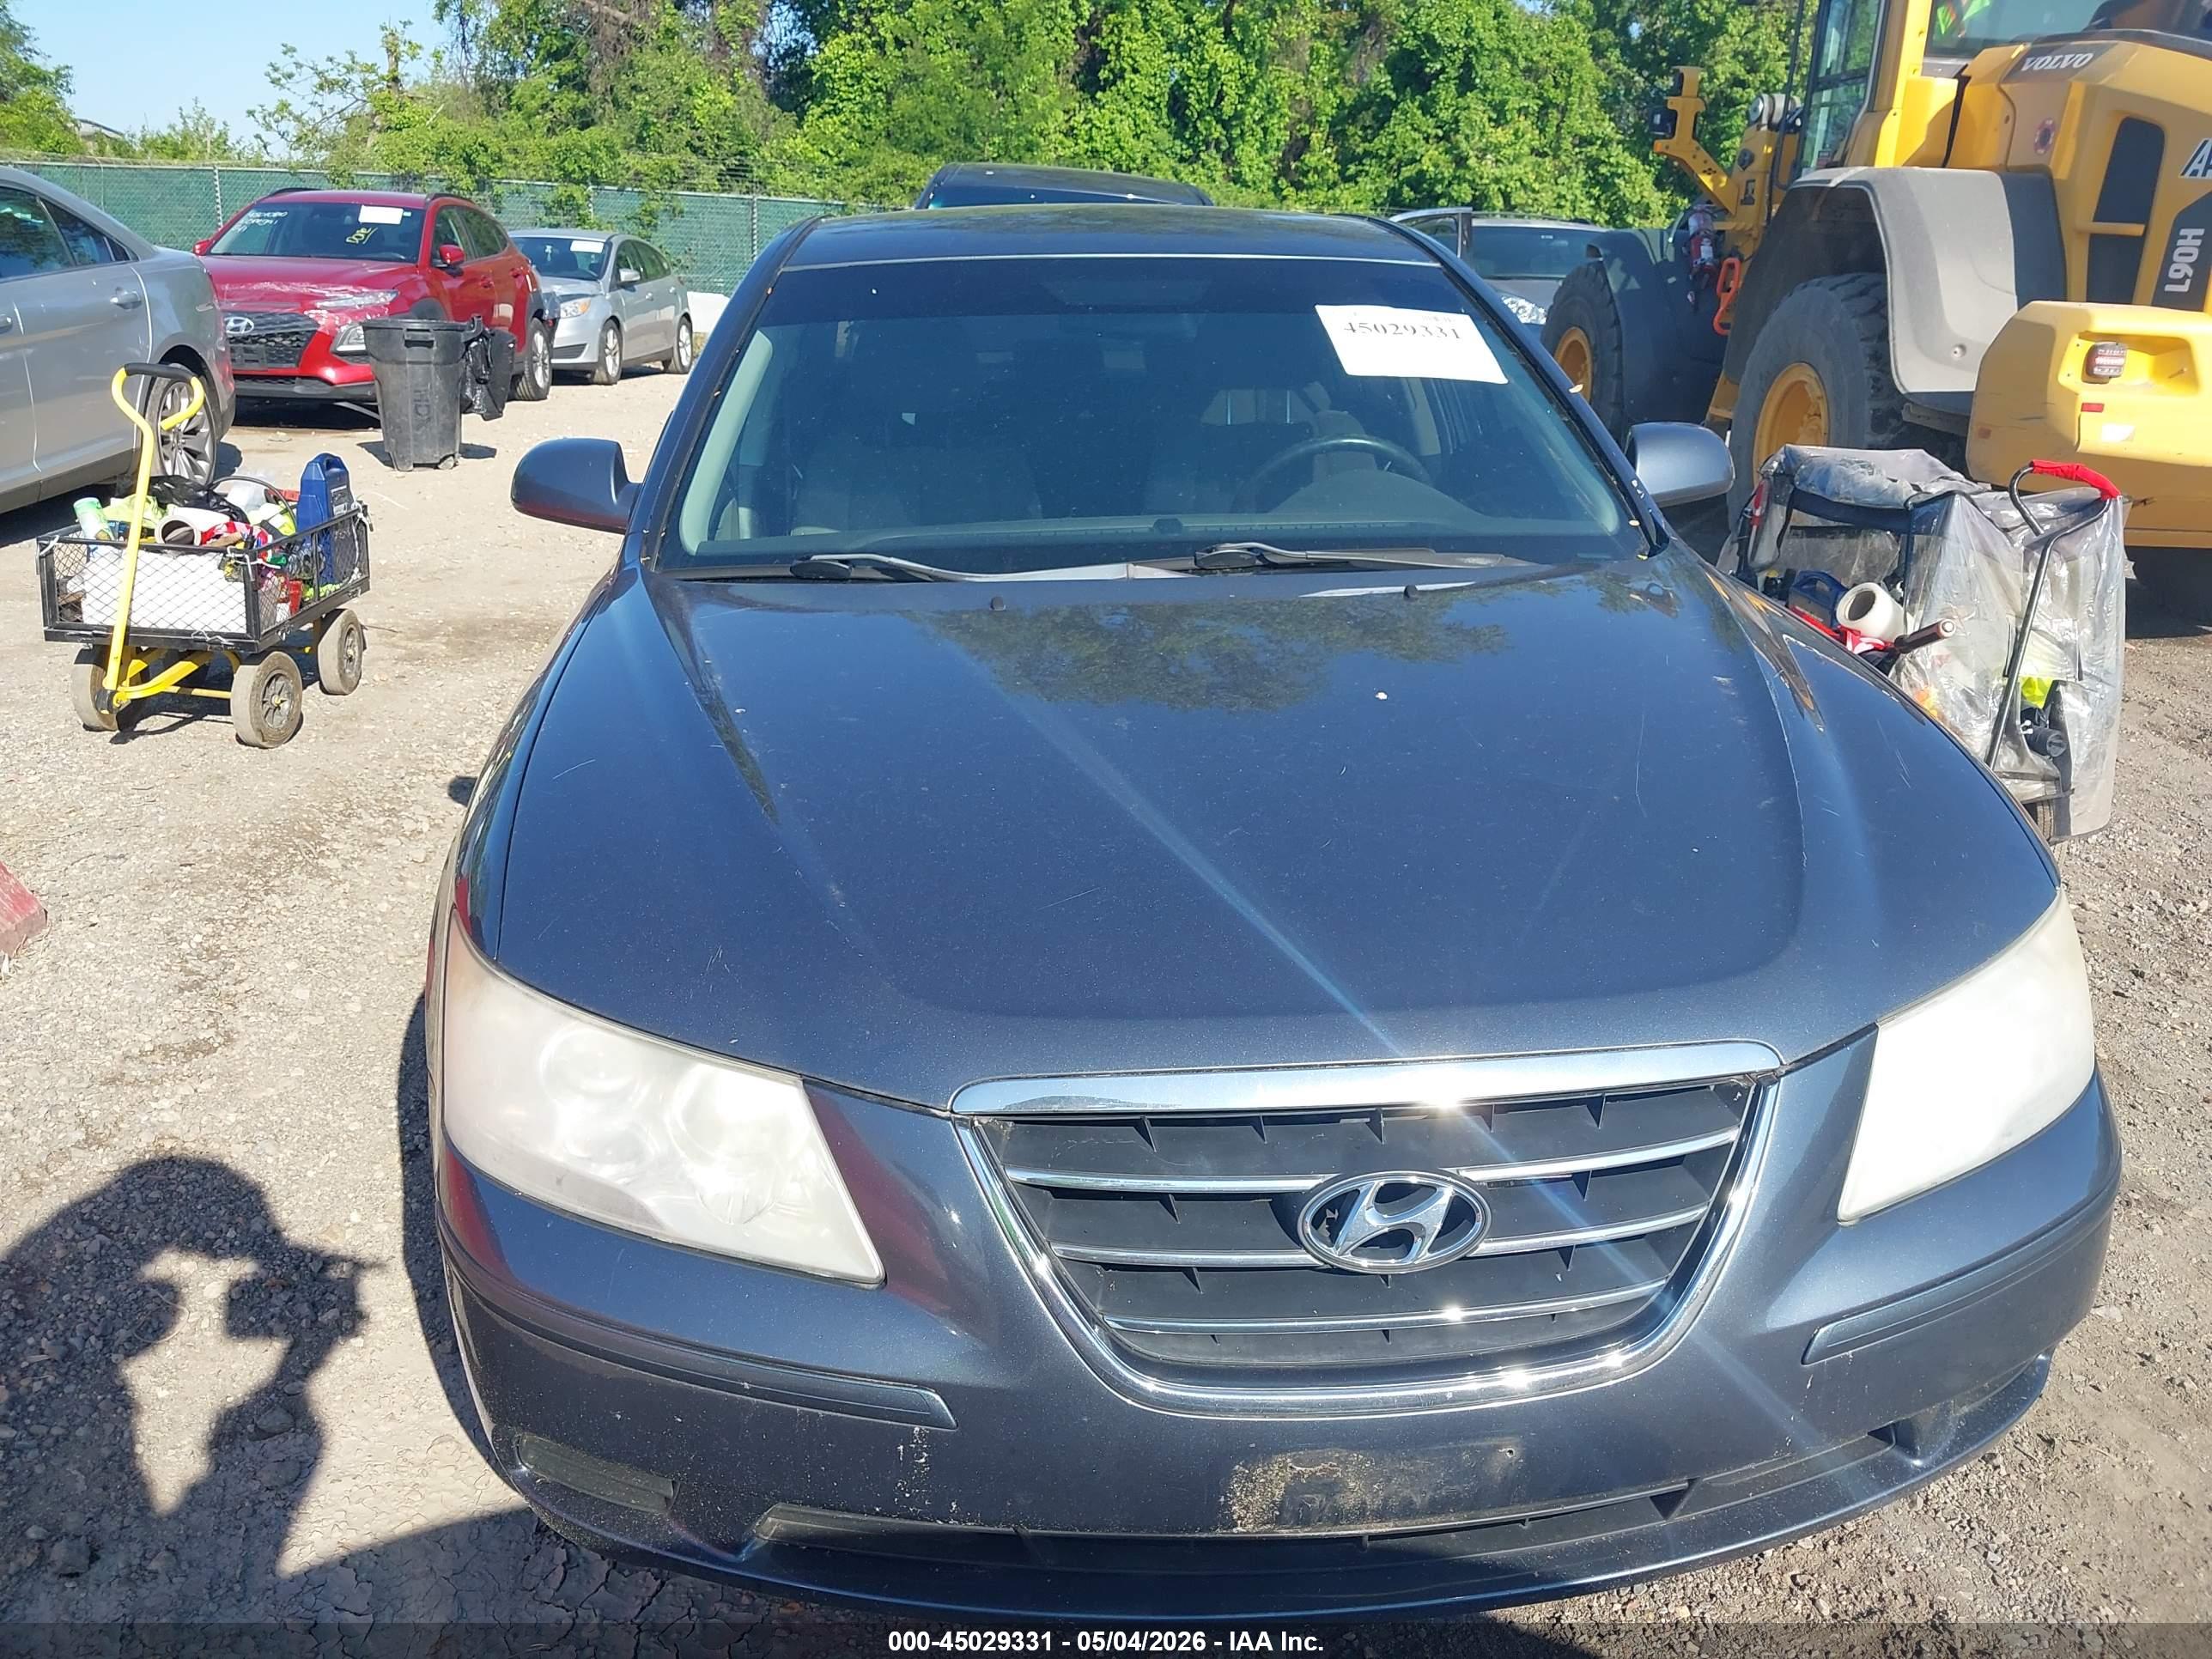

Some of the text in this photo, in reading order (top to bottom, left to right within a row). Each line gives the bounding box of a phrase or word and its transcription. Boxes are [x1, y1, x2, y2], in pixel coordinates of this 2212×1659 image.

[2021, 52, 2094, 71] VOLVO
[2164, 228, 2205, 293] L90H
[1343, 321, 1462, 340] 45029331
